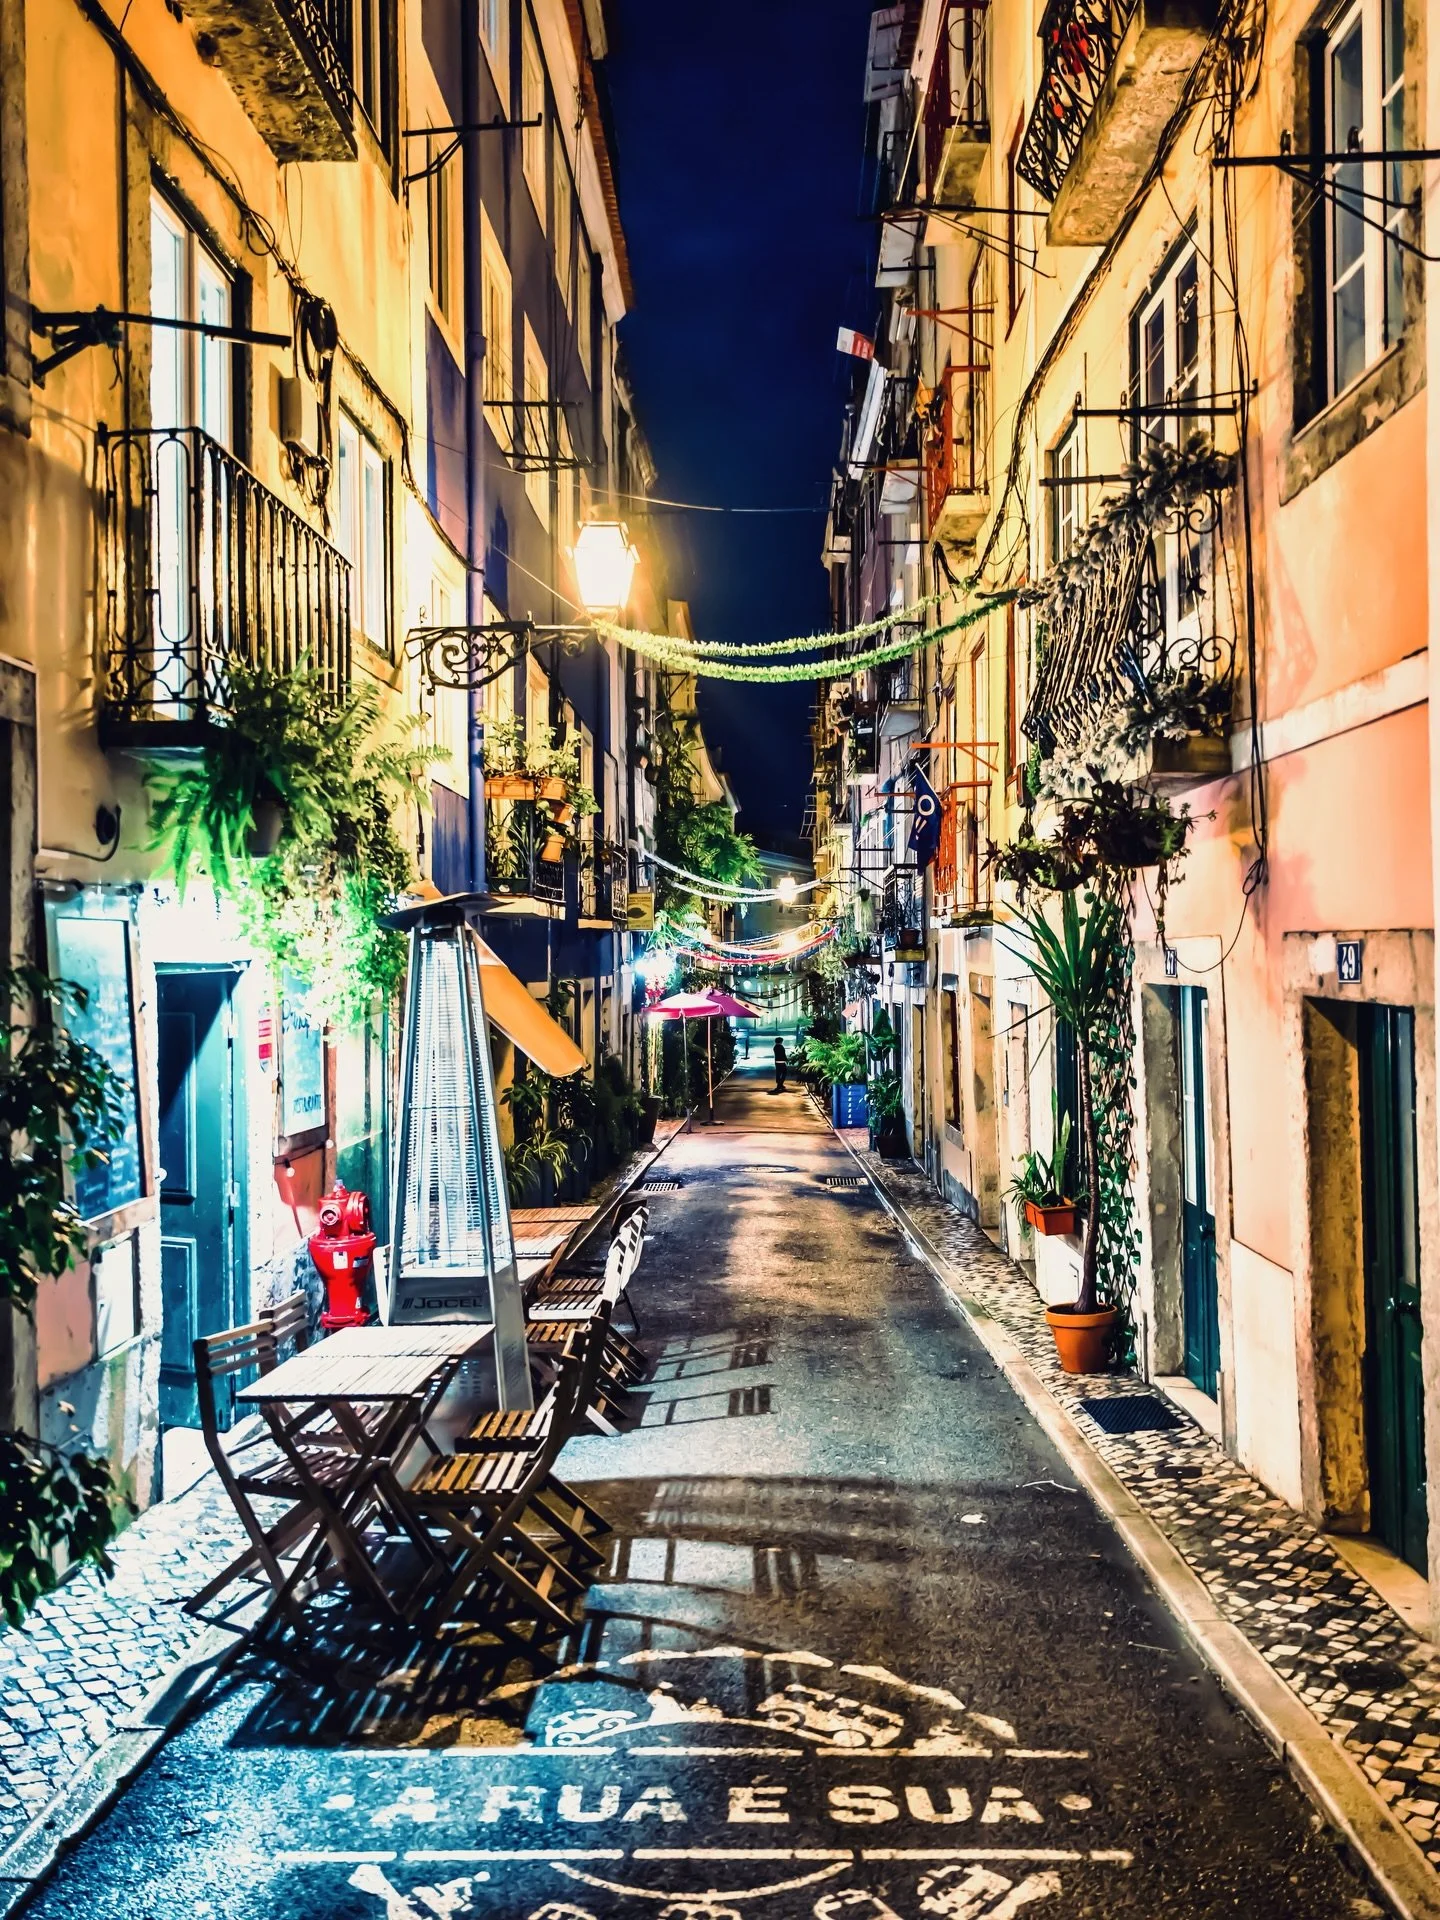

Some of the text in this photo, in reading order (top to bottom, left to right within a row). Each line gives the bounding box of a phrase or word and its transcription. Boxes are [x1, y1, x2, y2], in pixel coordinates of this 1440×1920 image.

[1341, 945, 1356, 980] 49
[414, 1296, 484, 1309] JOCEL
[369, 1785, 439, 1823] A
[478, 1785, 689, 1823] RUA
[826, 1784, 1045, 1824] SUA
